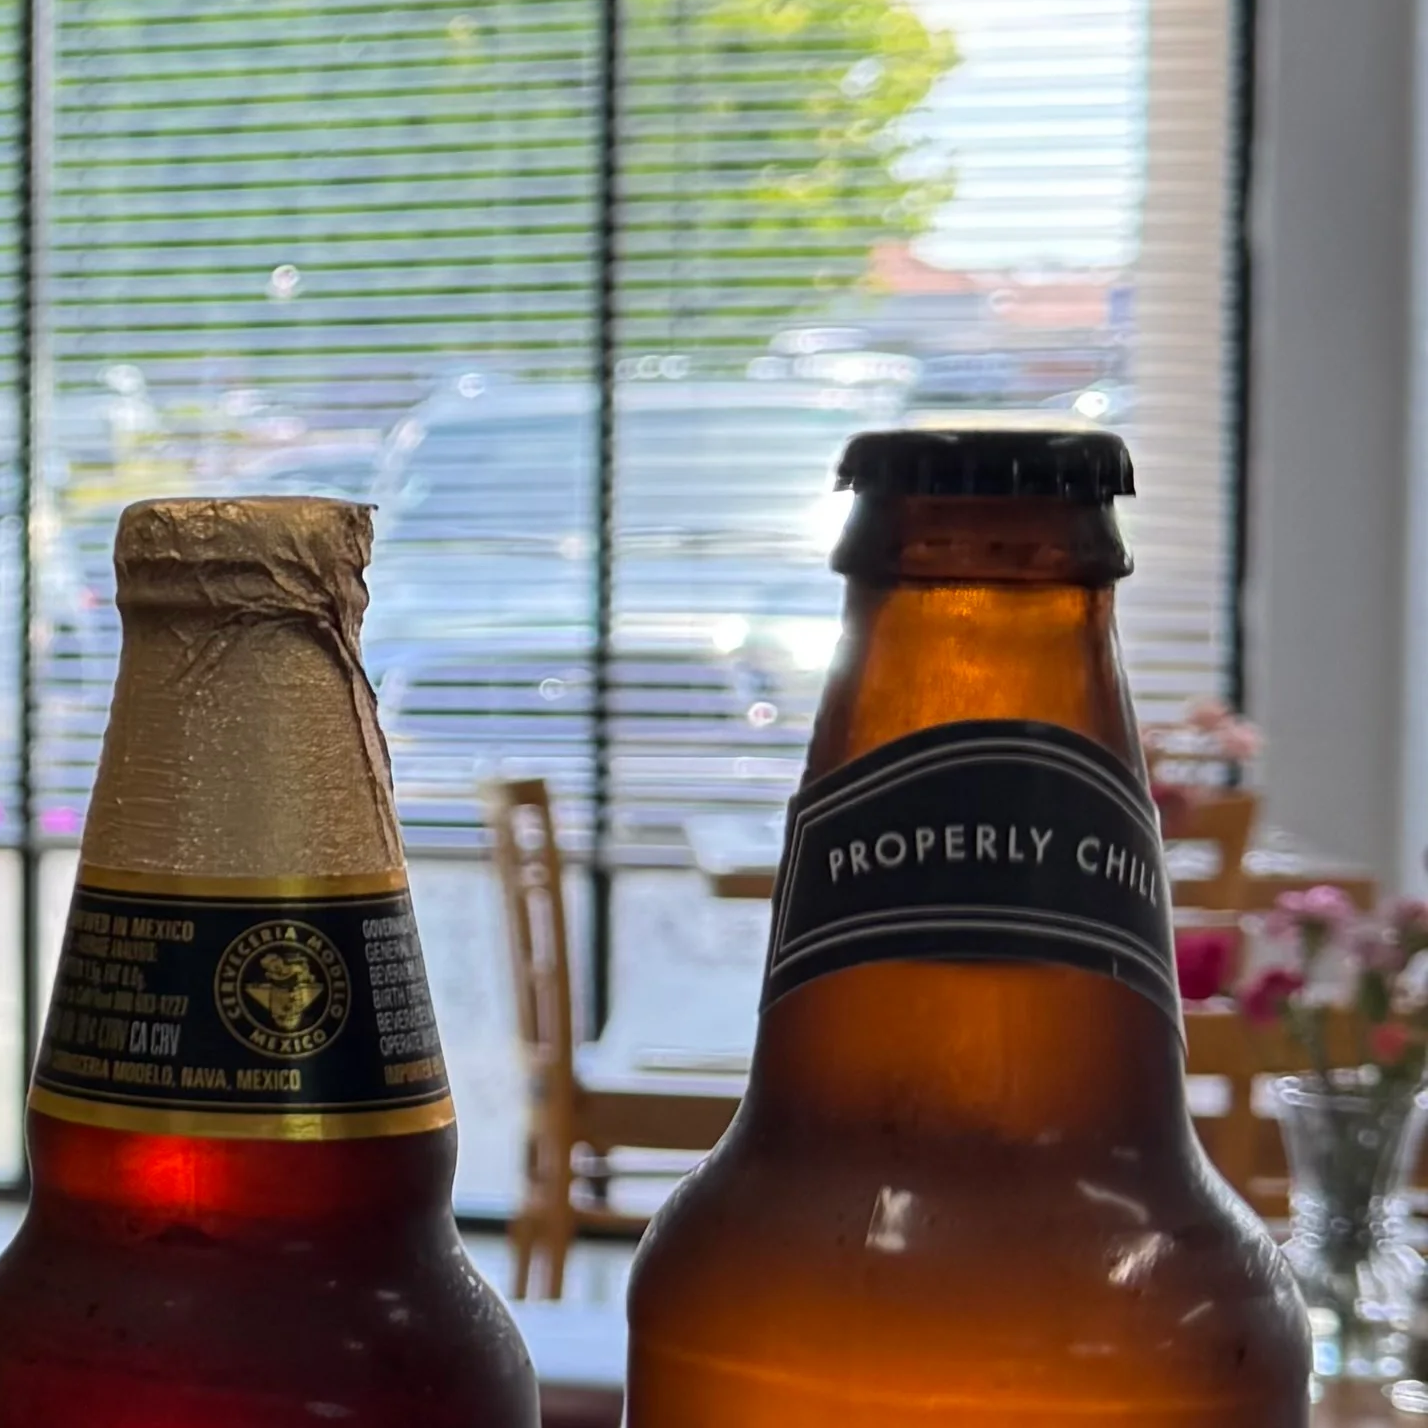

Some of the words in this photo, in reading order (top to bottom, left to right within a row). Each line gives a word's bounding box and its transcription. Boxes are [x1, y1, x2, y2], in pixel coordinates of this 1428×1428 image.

[829, 824, 1053, 883] PROPERLY
[130, 917, 194, 941] MEXICO
[150, 1022, 181, 1056] CRV
[249, 1029, 327, 1052] MEXICO
[236, 1068, 301, 1092] MEXICO
